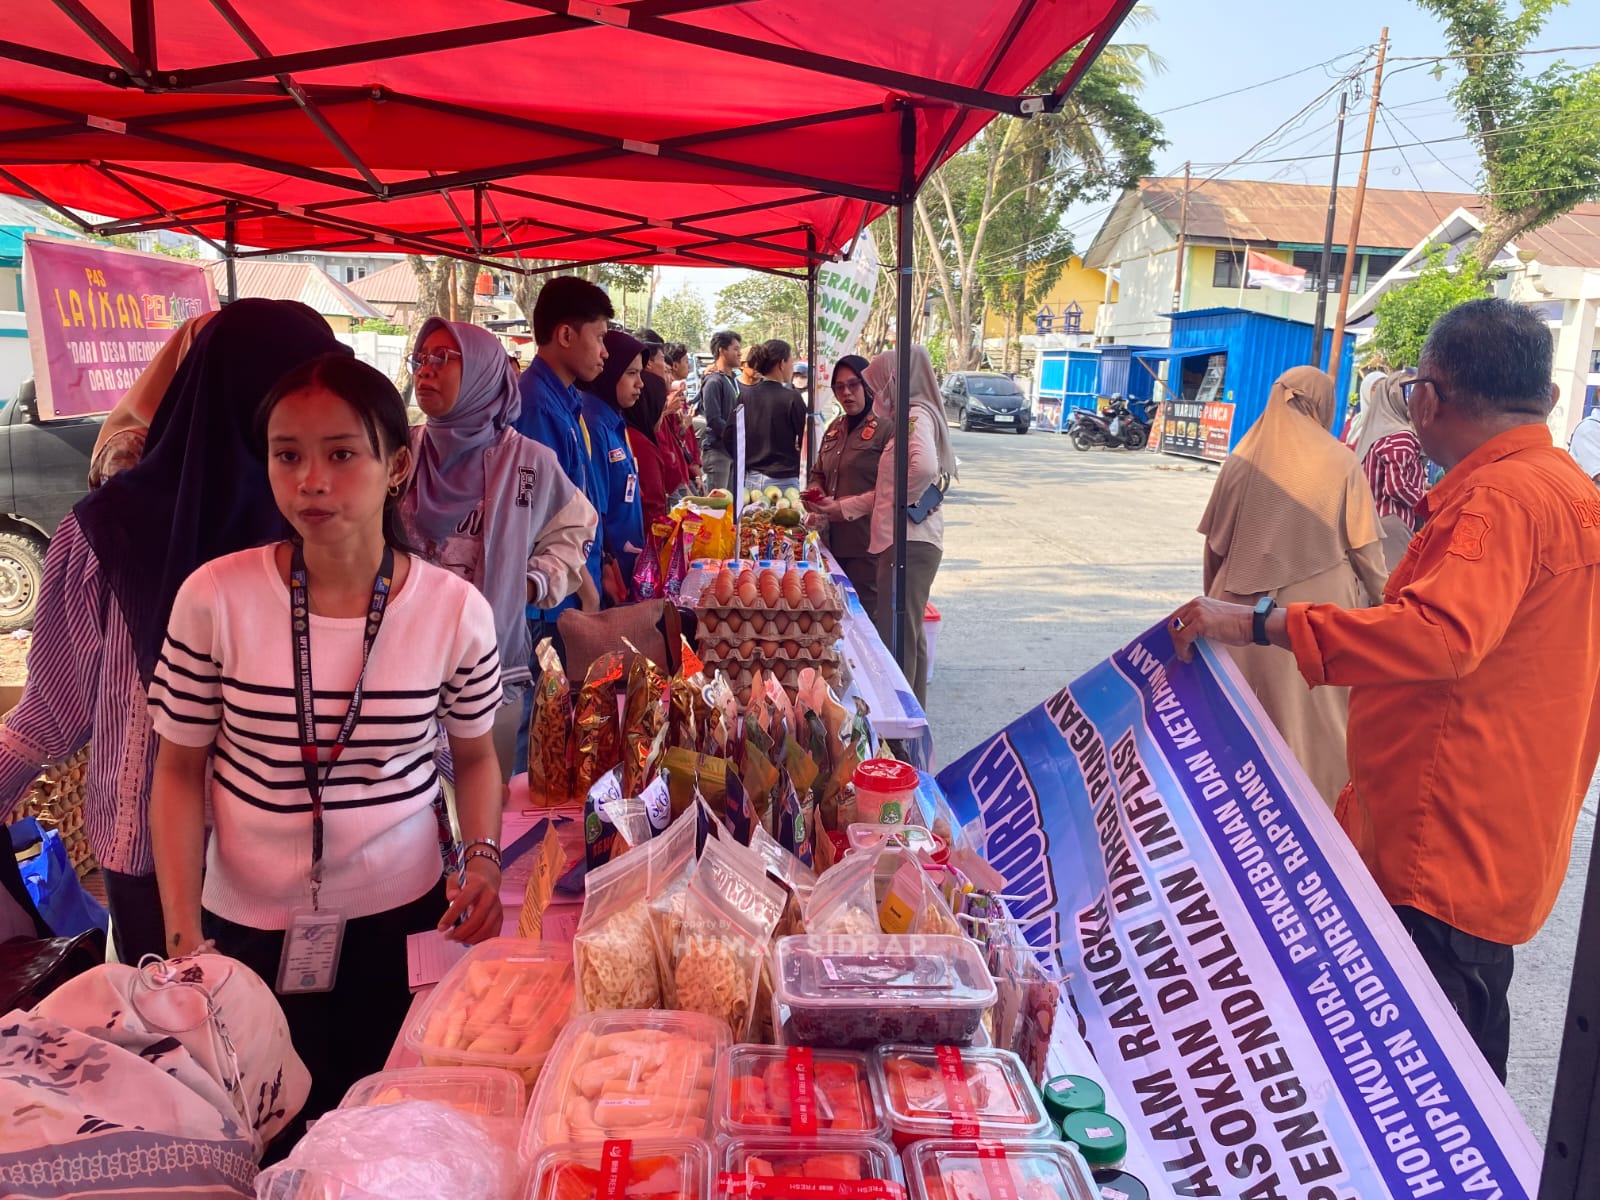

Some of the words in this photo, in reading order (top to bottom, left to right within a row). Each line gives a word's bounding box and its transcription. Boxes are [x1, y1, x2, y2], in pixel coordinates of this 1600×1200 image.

[54, 288, 145, 329] LASKAR
[85, 268, 106, 288] P4S
[88, 369, 116, 391] DARI
[100, 341, 127, 362] DESA
[1174, 403, 1203, 418] WARUNG
[1204, 405, 1228, 421] PANCA
[1047, 687, 1110, 804] PANGAN
[1111, 729, 1184, 862] INFLASI
[1184, 750, 1229, 801] DAN
[968, 732, 1058, 929] MURAH
[1097, 791, 1153, 914] HARGA
[1234, 759, 1309, 874] RAPPANG
[1212, 799, 1318, 964] PERKEBUNAN
[1079, 893, 1161, 1061] RANGKA
[1128, 919, 1199, 1015] DAN
[1296, 871, 1400, 1028] SIDENRENG
[1307, 961, 1446, 1199] HORTIKULTURA,
[1383, 1029, 1503, 1200] ABUPATEN
